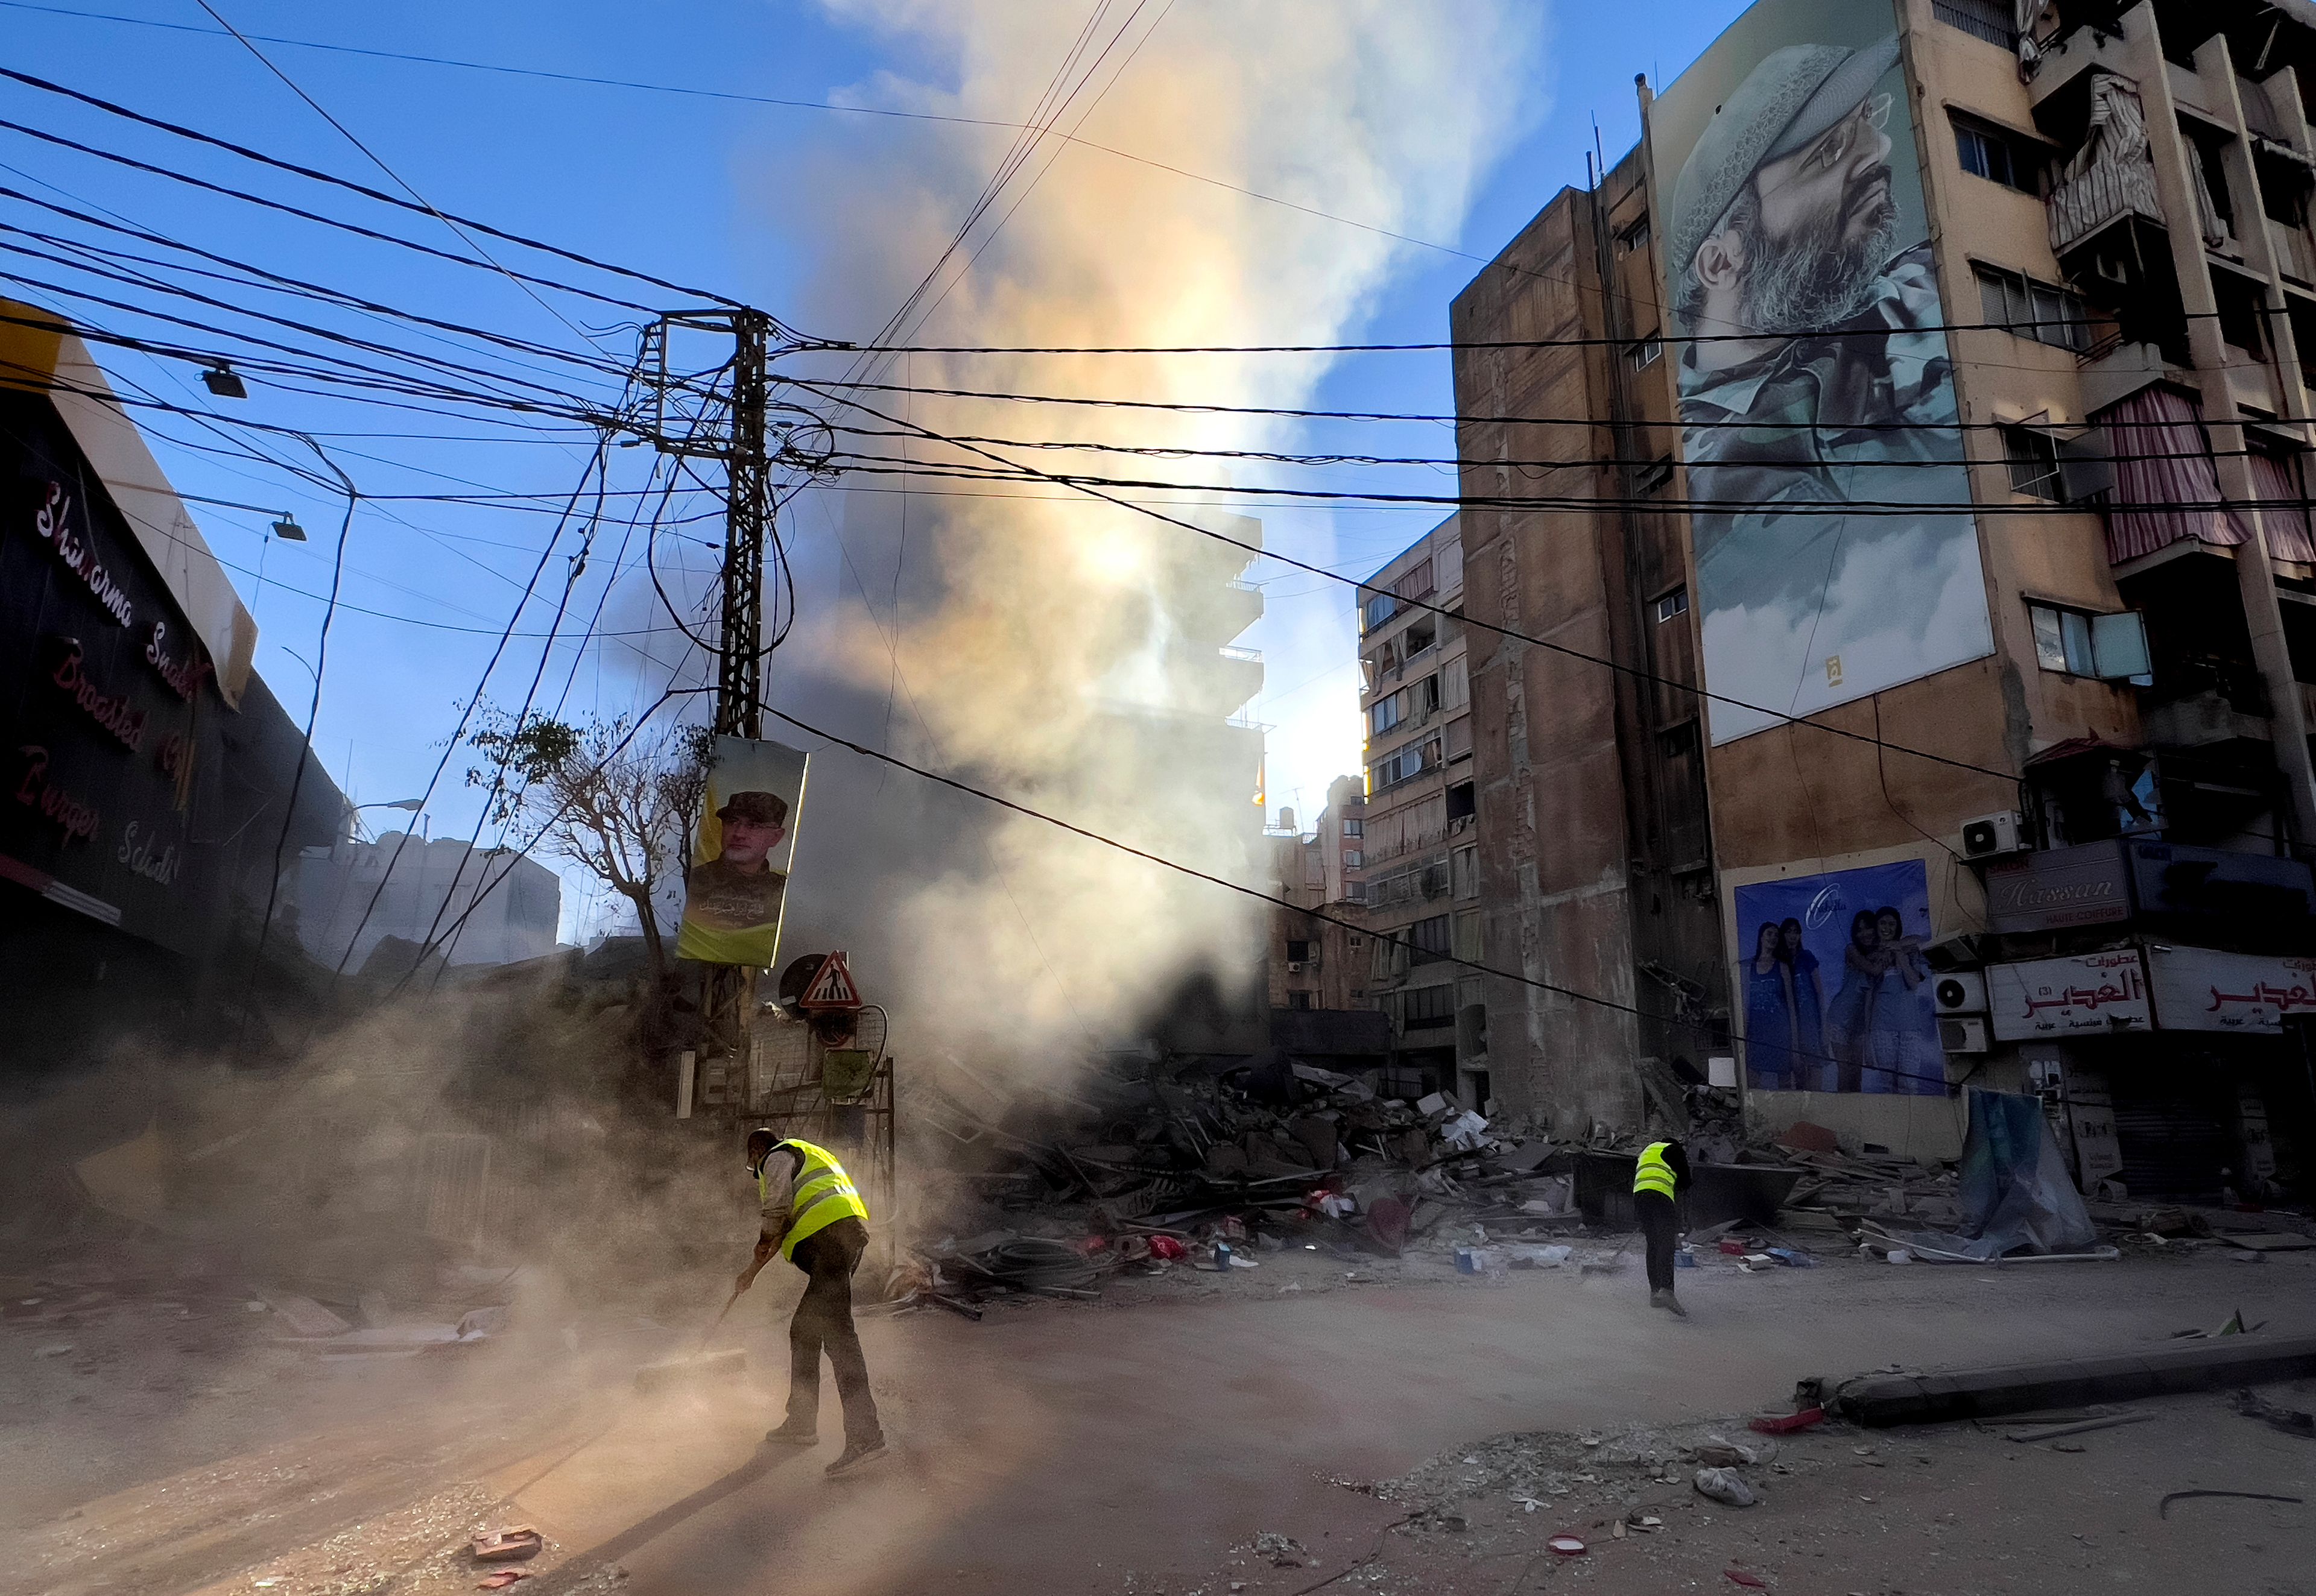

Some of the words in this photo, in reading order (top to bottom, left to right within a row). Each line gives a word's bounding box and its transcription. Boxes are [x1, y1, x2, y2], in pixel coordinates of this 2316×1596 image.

[1990, 859, 2030, 874] SALON
[1998, 878, 2113, 908] Hassan
[2022, 968, 2144, 1019] الغدير
[2038, 986, 2052, 996] (3)
